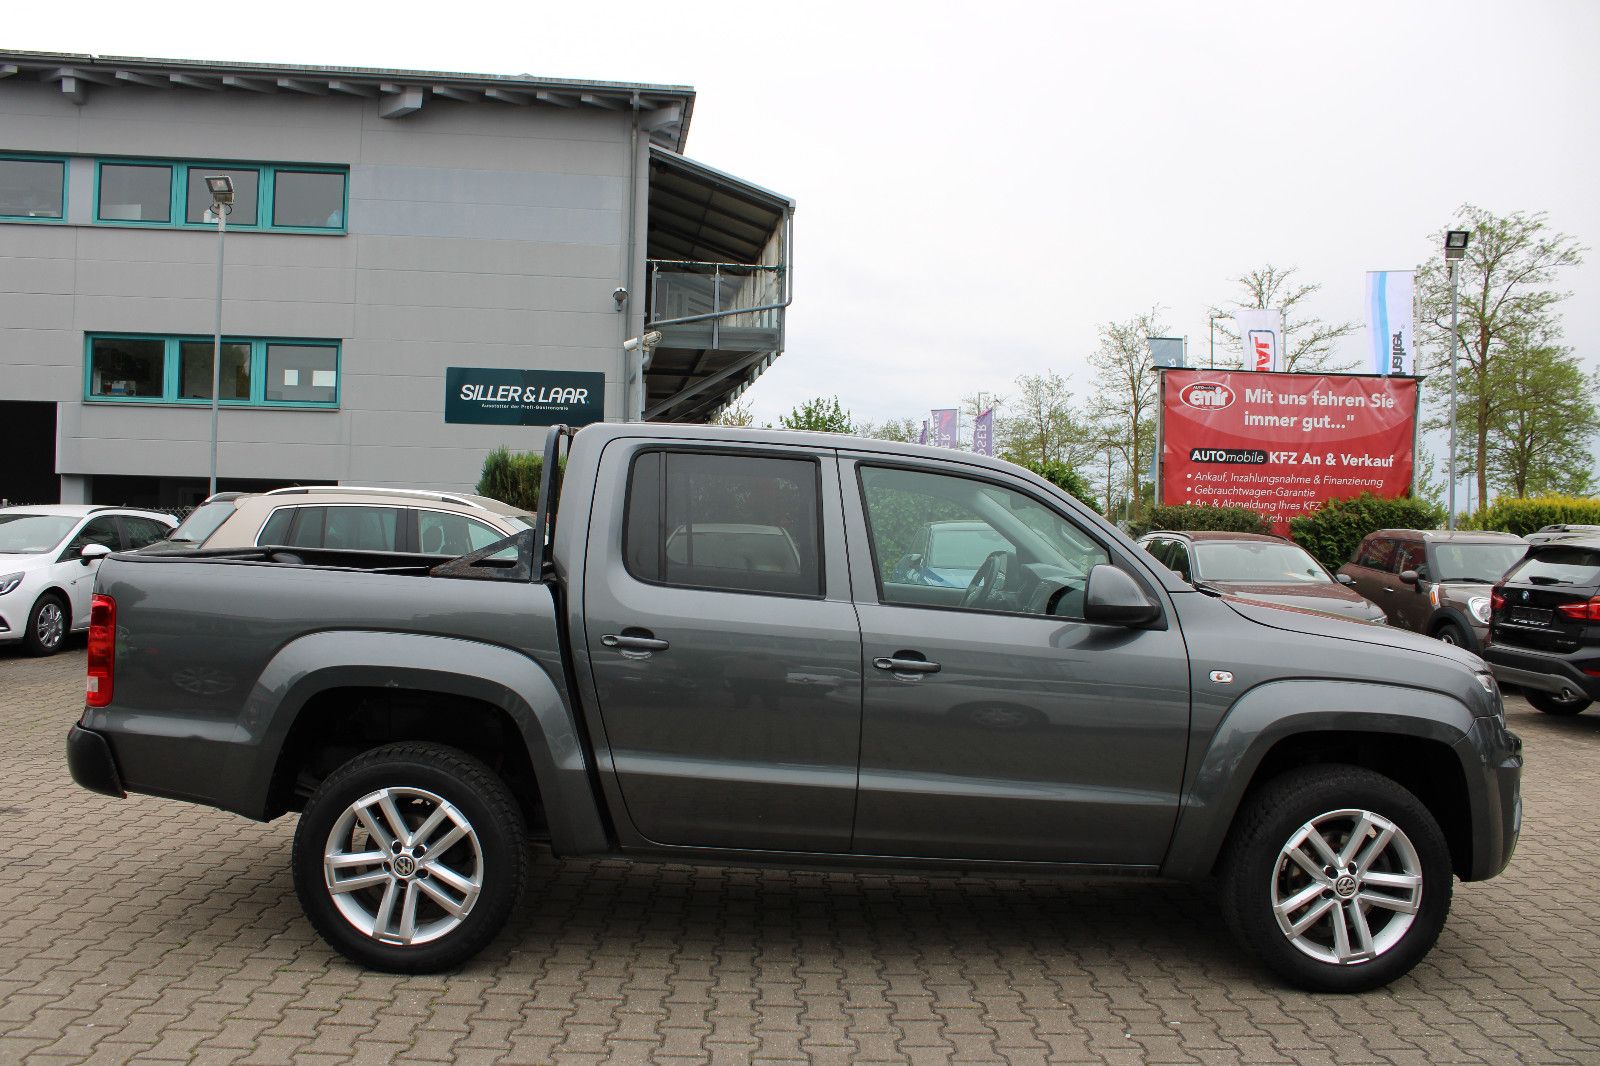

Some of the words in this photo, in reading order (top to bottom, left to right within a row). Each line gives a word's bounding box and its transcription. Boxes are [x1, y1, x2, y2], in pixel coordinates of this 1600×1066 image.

[460, 384, 522, 402] SILLER
[523, 386, 536, 403] &
[1189, 386, 1229, 406] emir
[1245, 388, 1274, 405] Mit
[1278, 393, 1307, 406] uns
[1312, 390, 1365, 408] fahren
[1370, 393, 1395, 409] Sie
[1244, 411, 1298, 428] immer
[1191, 450, 1264, 463] AUTOmobile
[1269, 451, 1298, 465] KFZ
[1301, 452, 1321, 466] An
[1325, 453, 1337, 467] &
[1341, 453, 1394, 469] Verkauf
[1194, 471, 1228, 483] Ankauf,
[1230, 472, 1311, 485] Inzahlungsnahme
[1313, 475, 1321, 485] &
[1323, 475, 1384, 488] Finanzierung
[1194, 484, 1316, 498] Gebrauchtwagen-Garantie
[1212, 498, 1220, 508] &
[1221, 499, 1276, 512] Abmeldung
[1278, 500, 1301, 510] Ihres
[1302, 502, 1322, 511] KFZ
